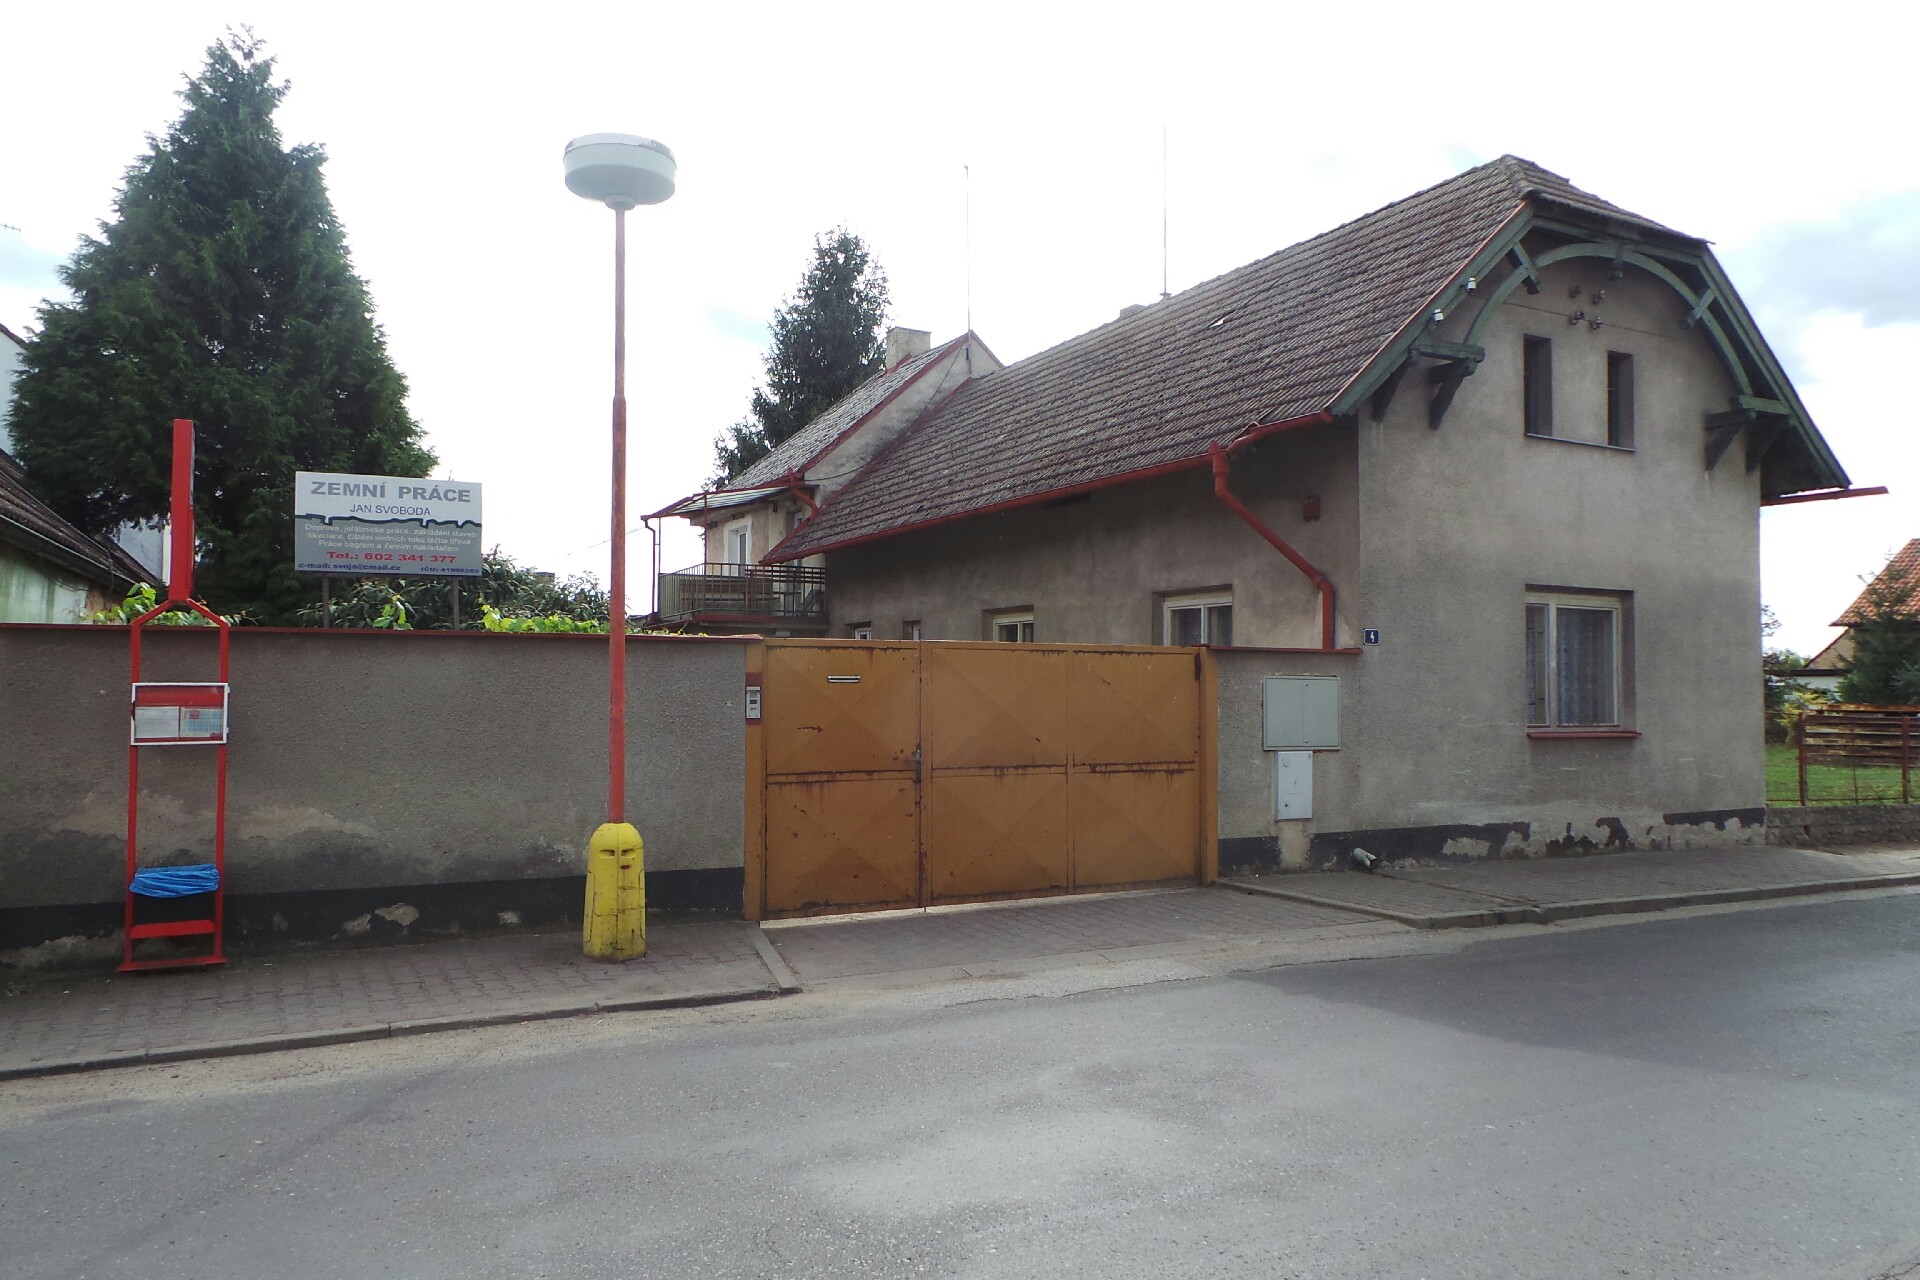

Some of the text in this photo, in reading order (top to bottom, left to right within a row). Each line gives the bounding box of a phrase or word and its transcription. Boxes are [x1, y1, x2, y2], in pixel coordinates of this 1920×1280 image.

[311, 481, 471, 503] ZEMNÍ PRÁCE
[350, 504, 431, 516] JAN SVOBODA
[318, 540, 343, 548] Práce
[449, 538, 471, 546] dřeva
[327, 551, 457, 563] Tel.: 602 341 377
[1370, 631, 1375, 643] 4
